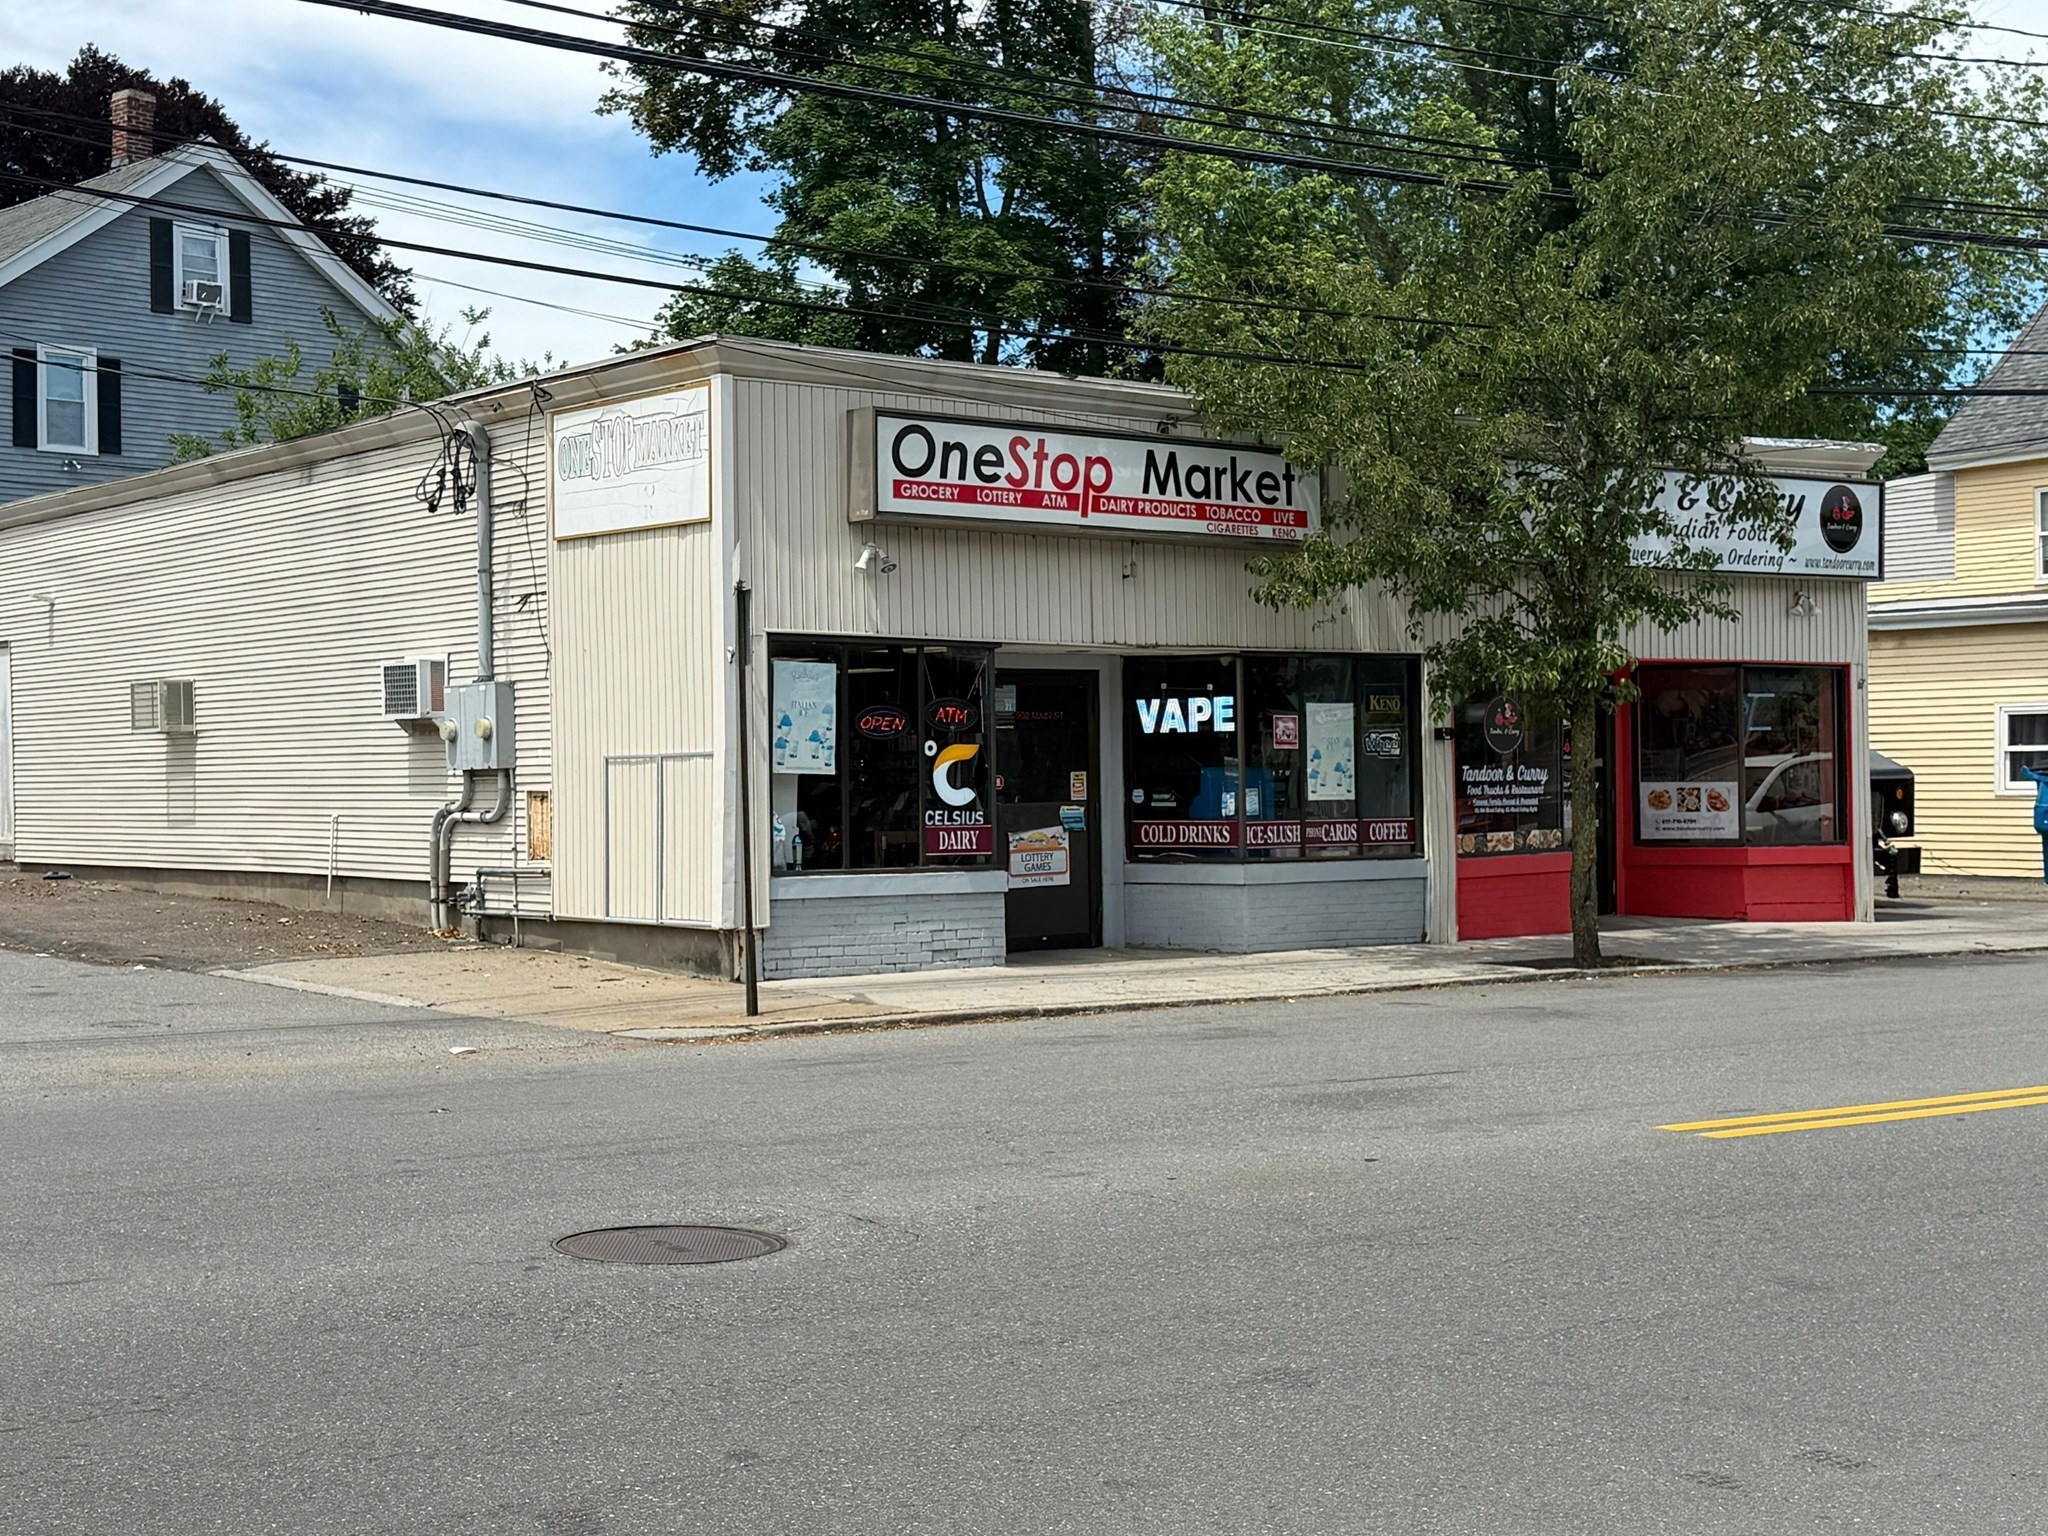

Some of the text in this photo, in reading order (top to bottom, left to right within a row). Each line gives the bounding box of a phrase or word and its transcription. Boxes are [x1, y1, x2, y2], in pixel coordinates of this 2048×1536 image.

[1142, 449, 1295, 506] Market
[900, 483, 1295, 525] GROCERY LOTTERY ATM DAIRY PRODUCTS TOBACCO LIVE
[1206, 522, 1297, 539] CIGARETTES KENO
[1728, 549, 1785, 571] Ordering
[1369, 695, 1401, 711] KENO
[860, 715, 905, 731] OPEN
[935, 707, 968, 723] ATM
[1136, 696, 1236, 733] VAPE
[1462, 765, 1549, 784] Tandoor & Curry
[1467, 785, 1481, 795] Food
[1483, 785, 1504, 795] Trucks
[1511, 785, 1544, 794] Restaurant
[925, 810, 984, 825] CELSIUS
[938, 830, 980, 850] DAIRY
[1141, 824, 1230, 843] COLD DRINKS
[1246, 824, 1301, 844] ICE-SLUSH
[1322, 823, 1357, 842] CARDS
[1369, 822, 1408, 841] COFFEE
[1020, 852, 1054, 863] LOTTERY
[1024, 862, 1052, 872] GAMES
